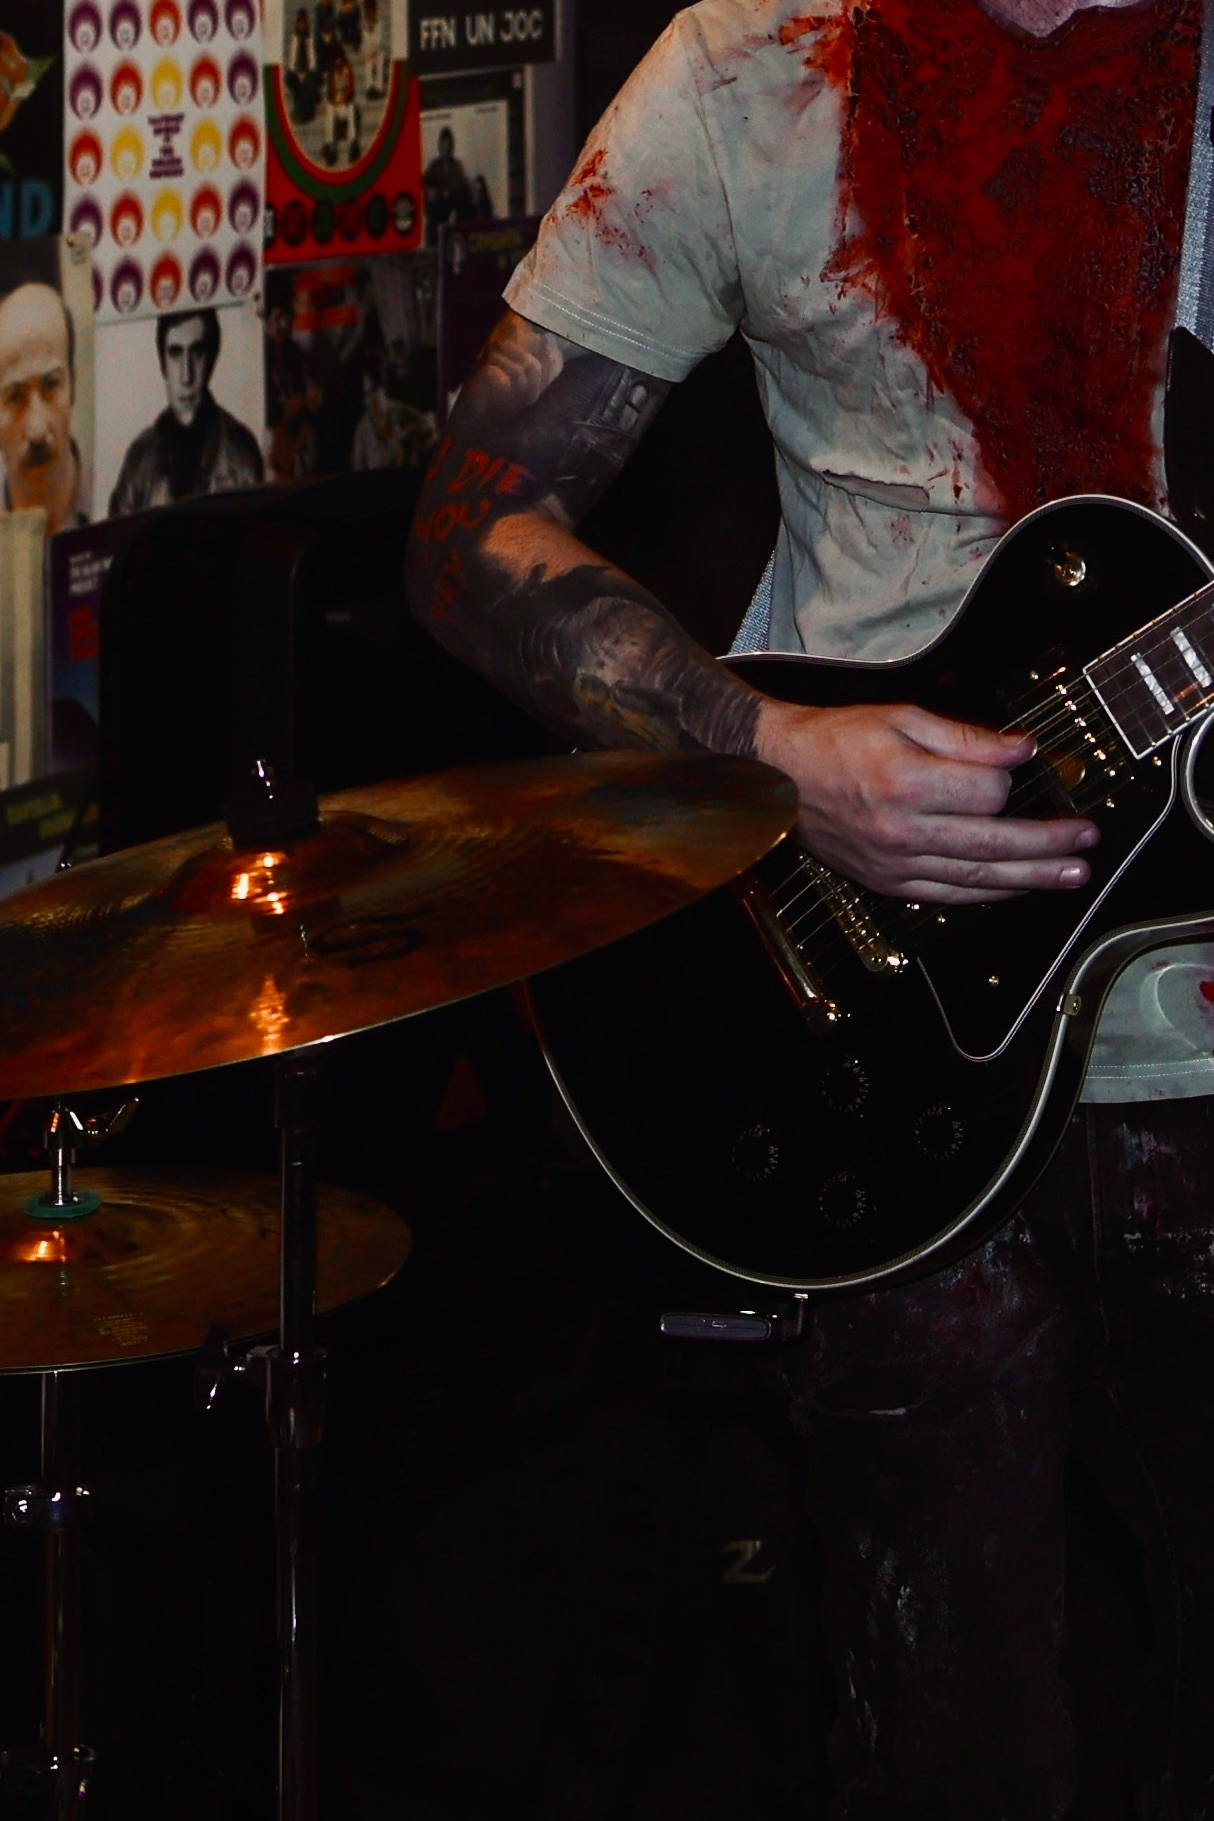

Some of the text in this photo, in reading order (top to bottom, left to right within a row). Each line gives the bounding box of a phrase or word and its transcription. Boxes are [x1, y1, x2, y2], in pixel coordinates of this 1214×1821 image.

[419, 7, 544, 52] FFN UN JOC
